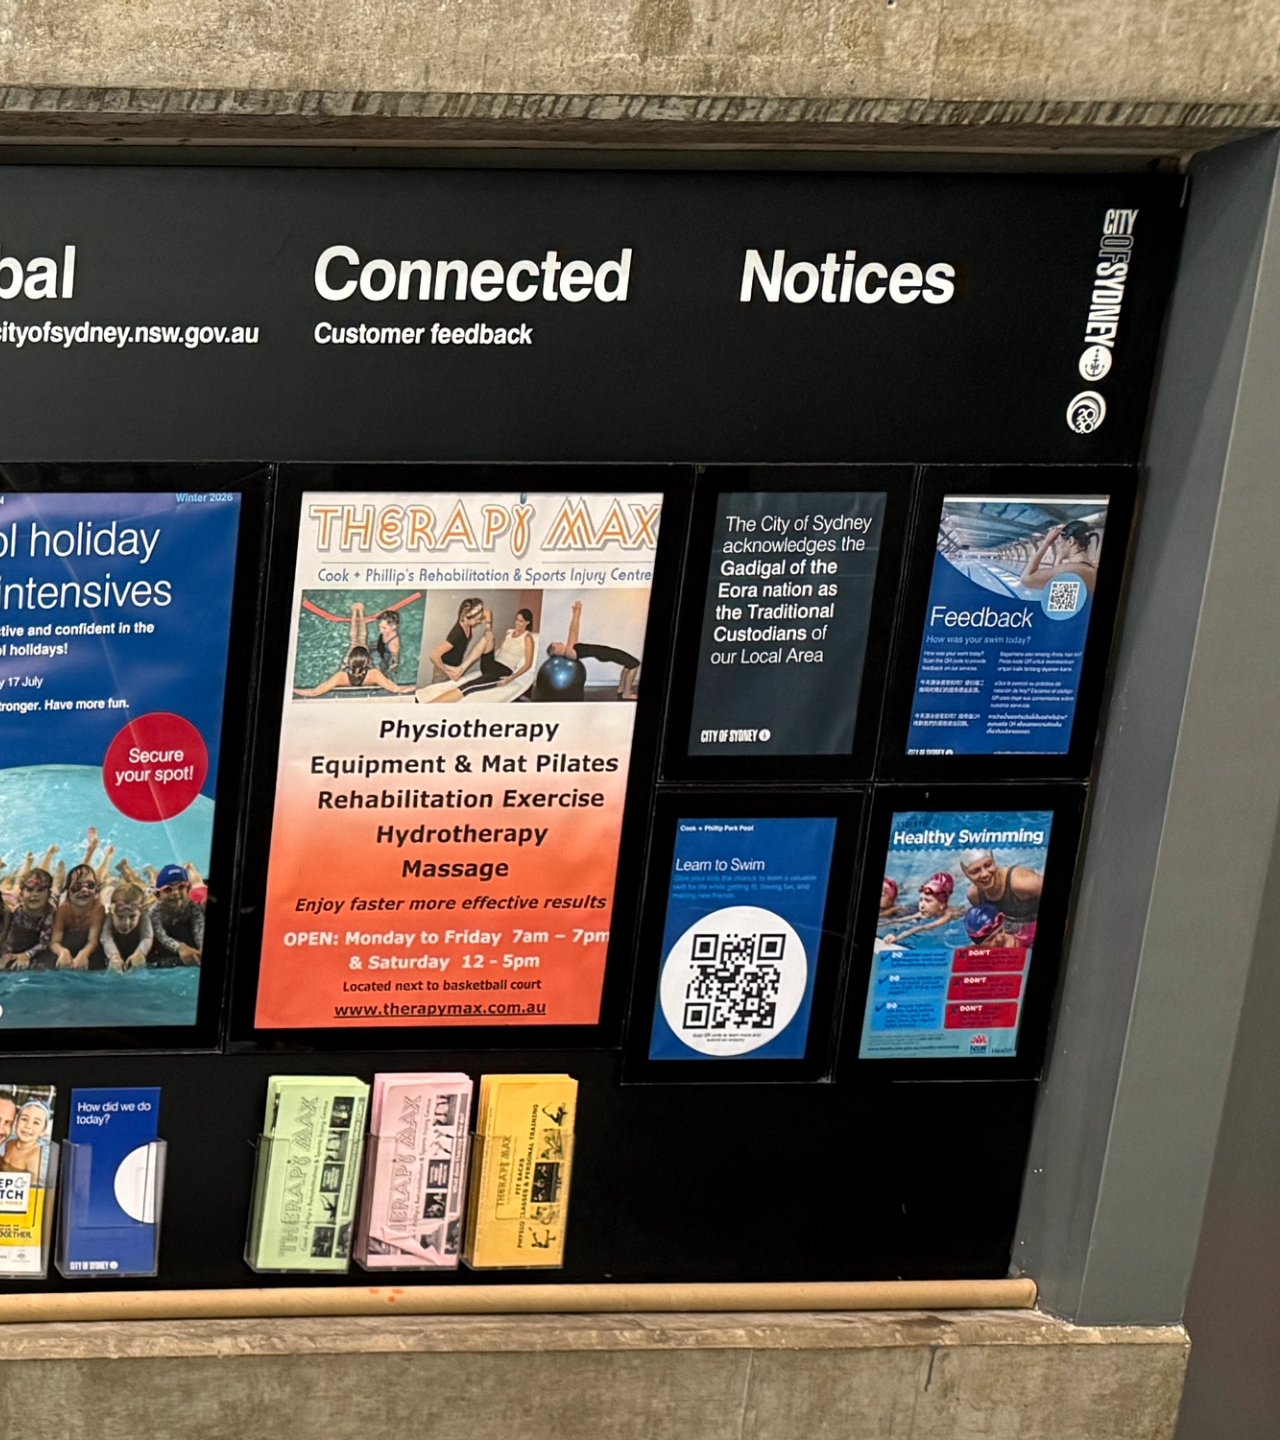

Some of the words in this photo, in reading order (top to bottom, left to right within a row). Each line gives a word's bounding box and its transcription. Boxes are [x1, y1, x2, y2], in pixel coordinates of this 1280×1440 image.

[1103, 208, 1139, 235] CITY
[1099, 235, 1134, 263] OF
[314, 245, 632, 302] Connected
[740, 249, 956, 305] Notices
[1085, 262, 1128, 348] SYDNEY
[314, 322, 425, 345] Customer
[430, 322, 533, 345] feedback
[309, 498, 536, 559] THERAPY
[541, 497, 663, 550] MAX
[726, 516, 756, 532] The
[760, 516, 790, 534] City
[794, 515, 808, 531] of
[812, 515, 872, 534] Sydney
[31, 521, 160, 564] holiday
[722, 537, 835, 556] acknowledges
[841, 537, 865, 551] the
[720, 560, 785, 579] Gadigal
[790, 560, 806, 575] of
[811, 560, 837, 574] the
[718, 583, 758, 597] Eora
[762, 583, 812, 597] nation
[817, 585, 837, 596] as
[715, 605, 743, 620] the
[747, 604, 834, 619] Traditional
[930, 606, 1033, 628] Feedback
[713, 627, 806, 642] Custodians
[811, 625, 827, 640] of
[710, 653, 737, 664] our
[740, 650, 782, 664] Local
[786, 649, 824, 663] Area
[8, 677, 20, 687] 17
[22, 676, 43, 690] July
[379, 719, 559, 743] Physiotherapy
[129, 748, 184, 763] Secure
[310, 755, 446, 777] Equipment
[455, 756, 471, 773] &
[481, 754, 526, 773] Mat
[536, 753, 618, 772] Pilates
[115, 769, 149, 784] your
[154, 766, 193, 784] spot!
[318, 791, 492, 808] Rehabilitation
[503, 789, 604, 807] Exercise
[376, 825, 548, 848] Hydrotherapy
[893, 829, 954, 846] Healthy
[959, 829, 1043, 846] Swimming
[402, 860, 509, 880] Massage
[676, 858, 711, 872] Learn
[714, 859, 726, 871] to
[730, 857, 765, 871] Swim
[334, 1000, 546, 1018] www.therapymax.com.au
